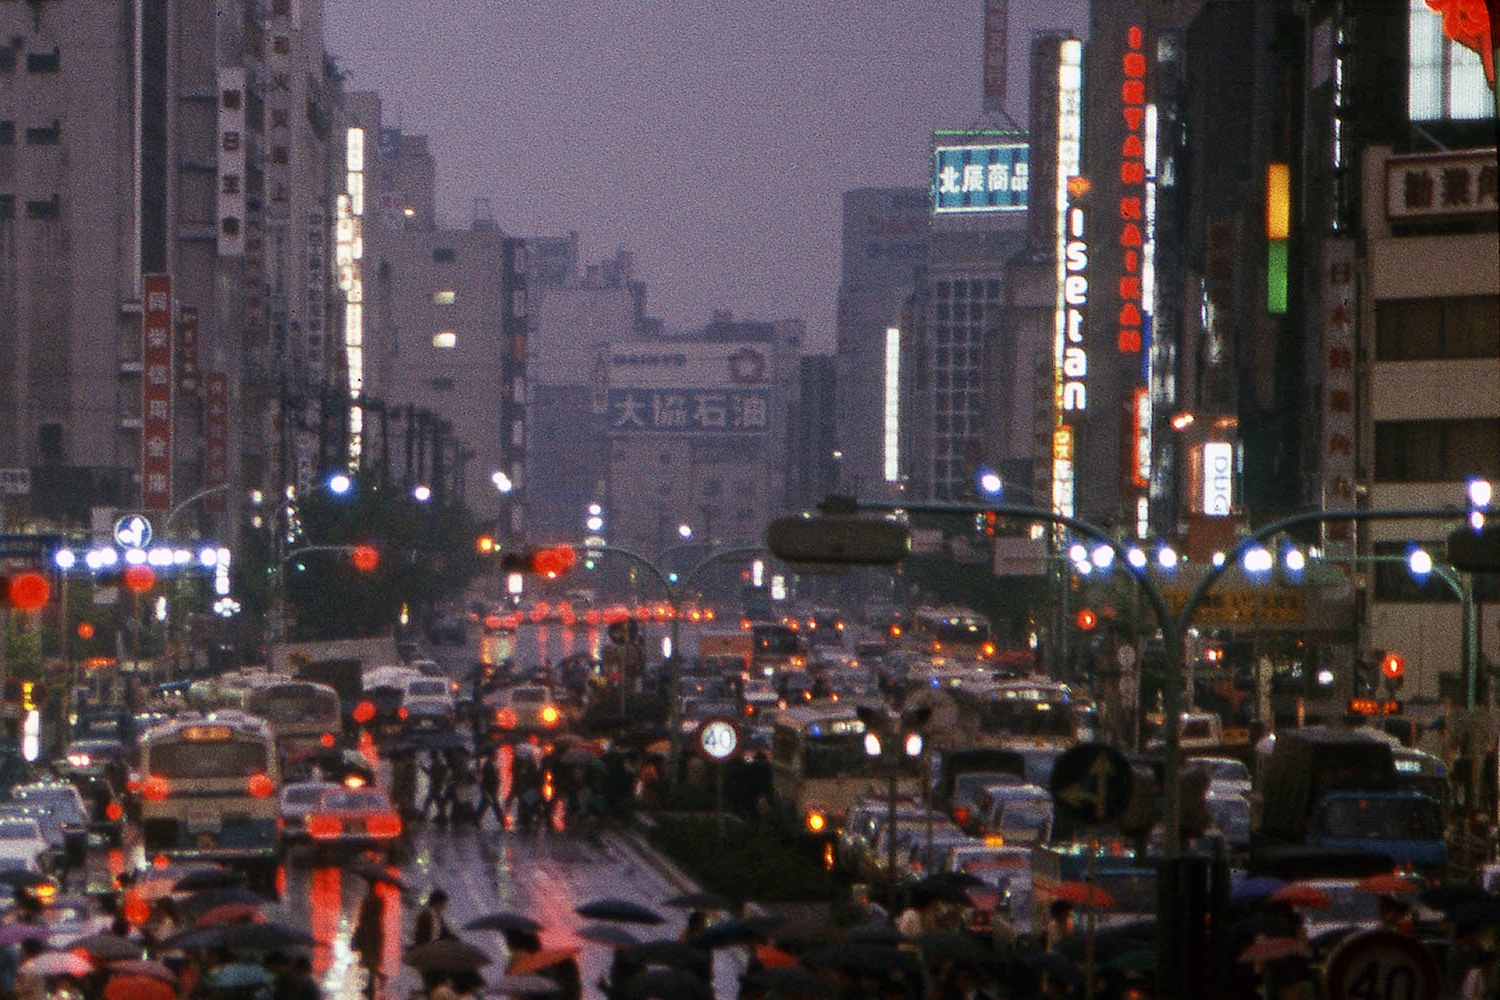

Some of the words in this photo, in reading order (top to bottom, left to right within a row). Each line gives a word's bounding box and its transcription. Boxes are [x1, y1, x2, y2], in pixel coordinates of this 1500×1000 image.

[1117, 197, 1143, 352] KAIKAN
[614, 393, 767, 428] 大協石油
